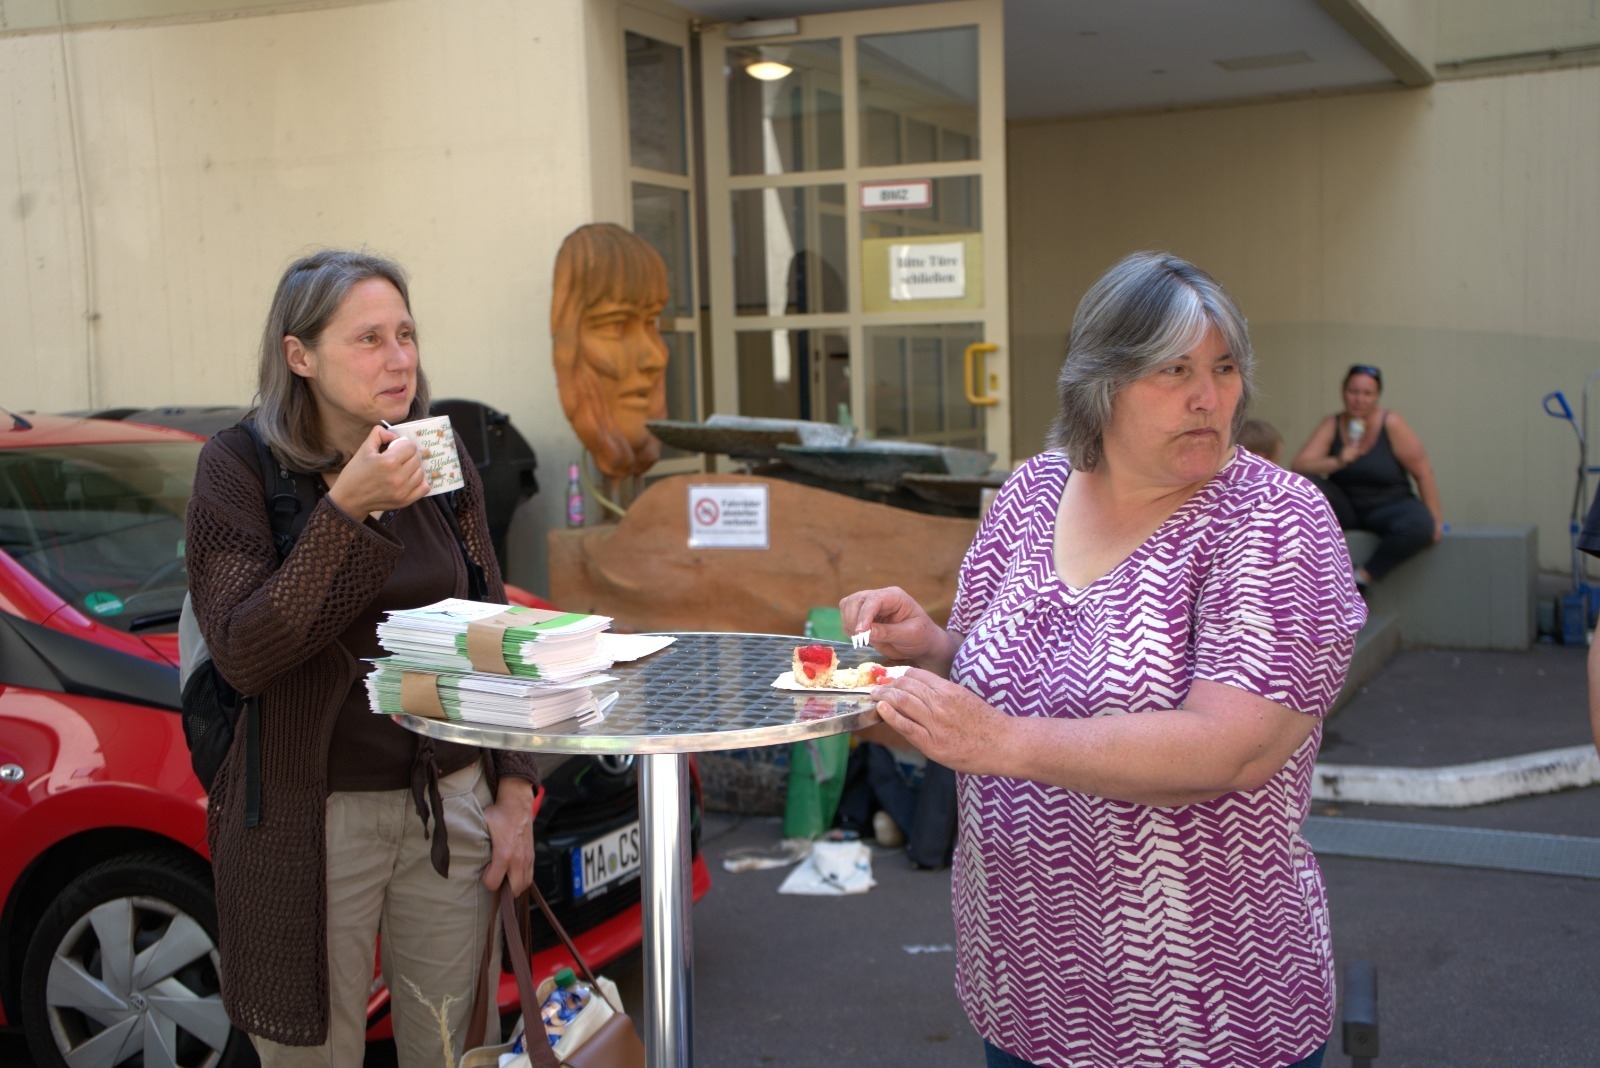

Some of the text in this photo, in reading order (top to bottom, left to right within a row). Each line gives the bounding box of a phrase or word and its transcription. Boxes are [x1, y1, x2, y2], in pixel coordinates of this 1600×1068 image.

[880, 189, 909, 202] BMZ
[584, 828, 639, 887] MA CS
